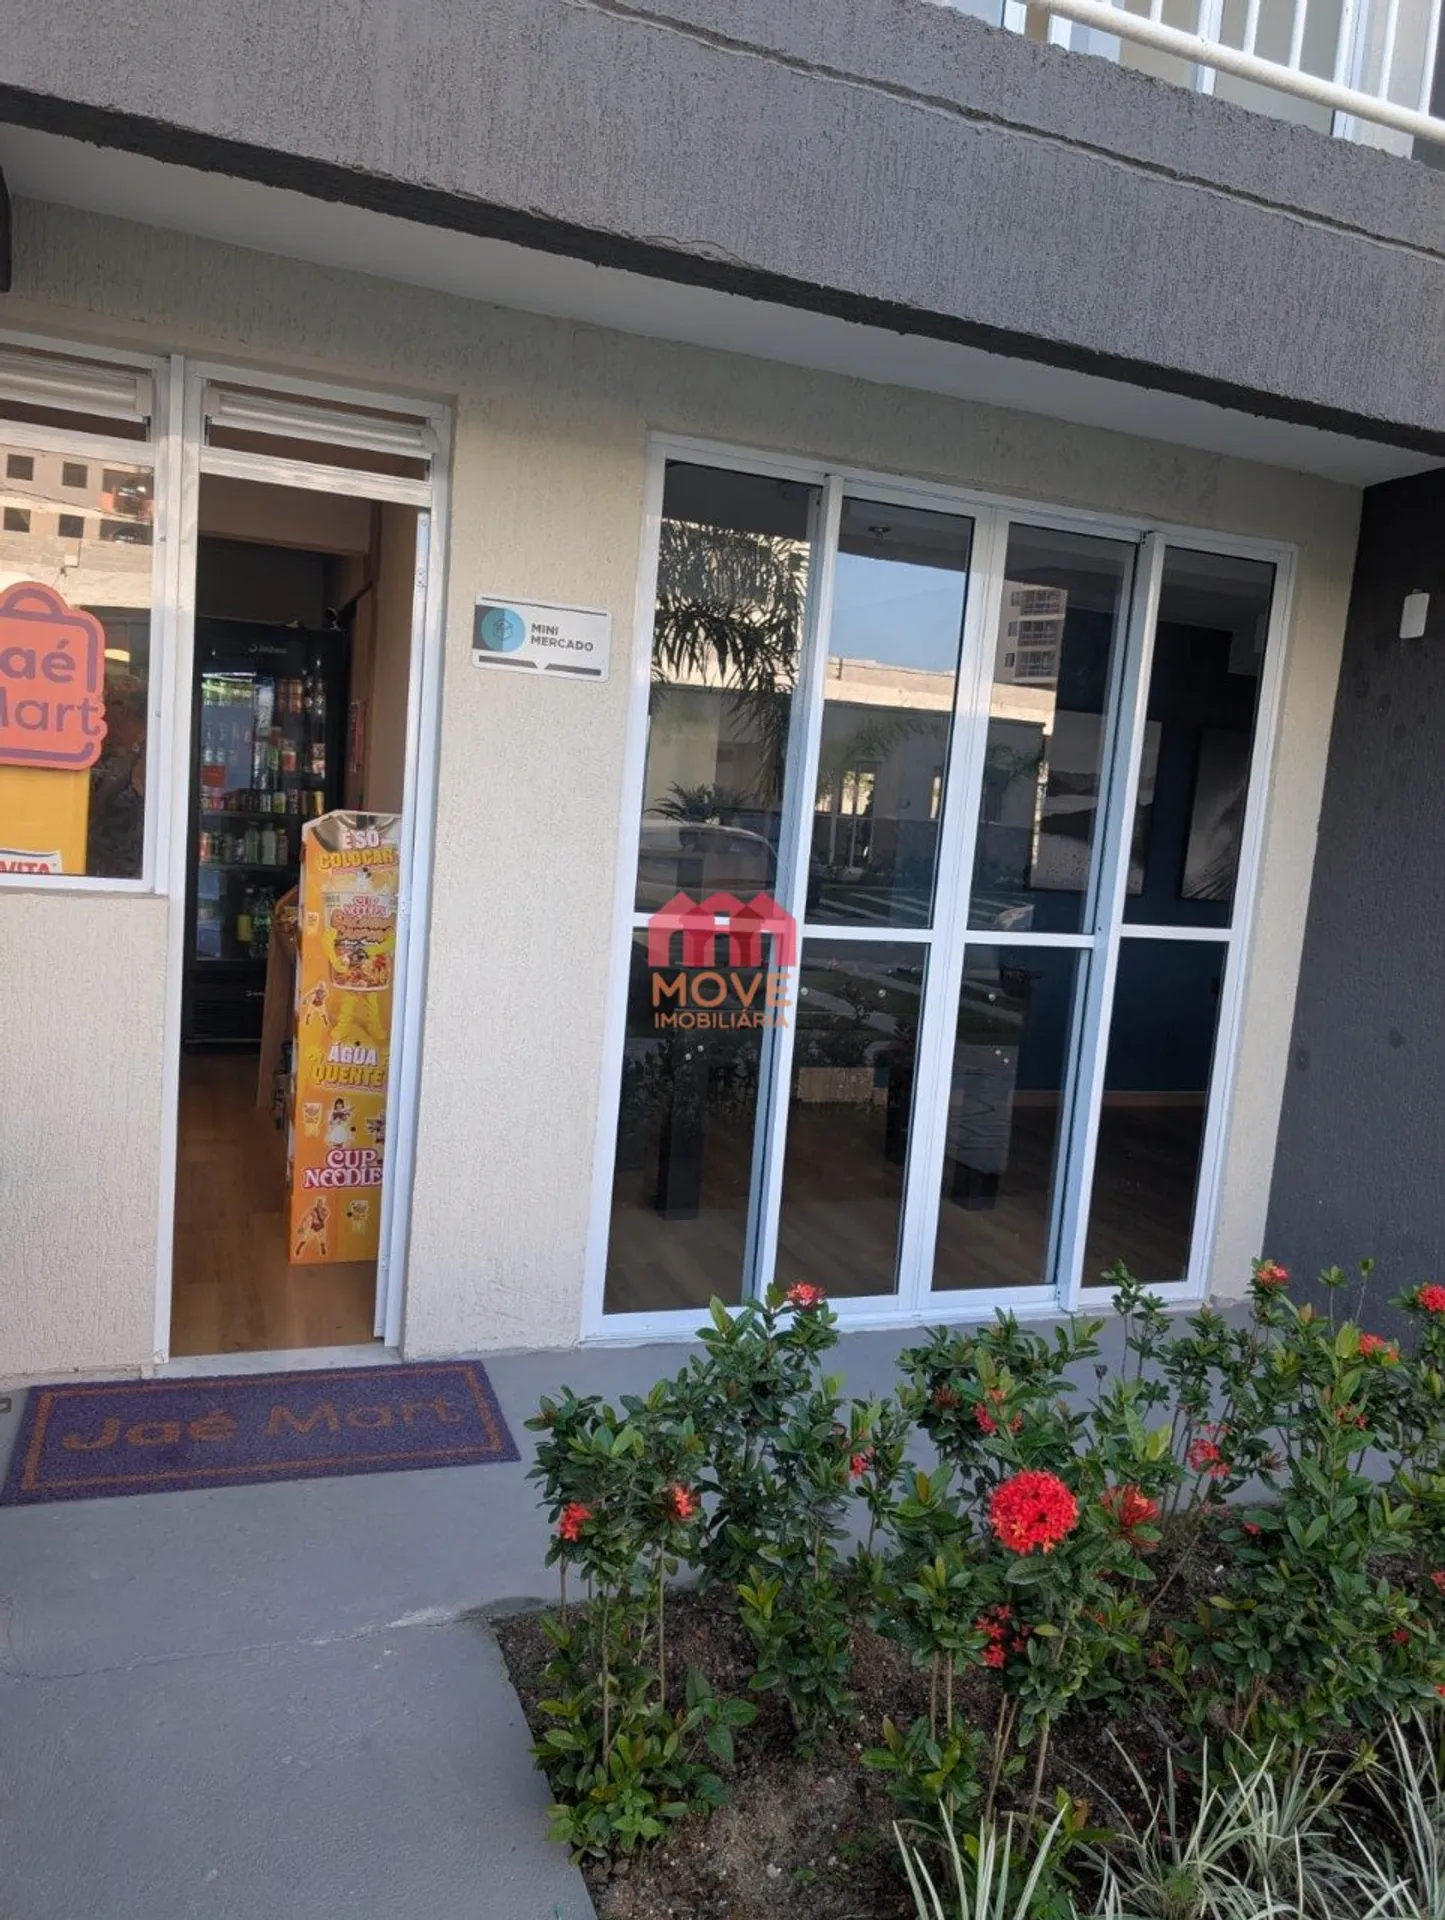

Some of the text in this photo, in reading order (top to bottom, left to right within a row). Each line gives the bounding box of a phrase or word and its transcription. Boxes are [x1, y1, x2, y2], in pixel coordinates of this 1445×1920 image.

[531, 623, 560, 636] MINI
[530, 635, 594, 652] MERCADO
[319, 847, 394, 869] COLOCAR
[328, 1040, 378, 1066] ÁGUA
[311, 1064, 385, 1088] QUENTE
[326, 1149, 377, 1169] CUP
[62, 1397, 462, 1450] Jaé Mart
